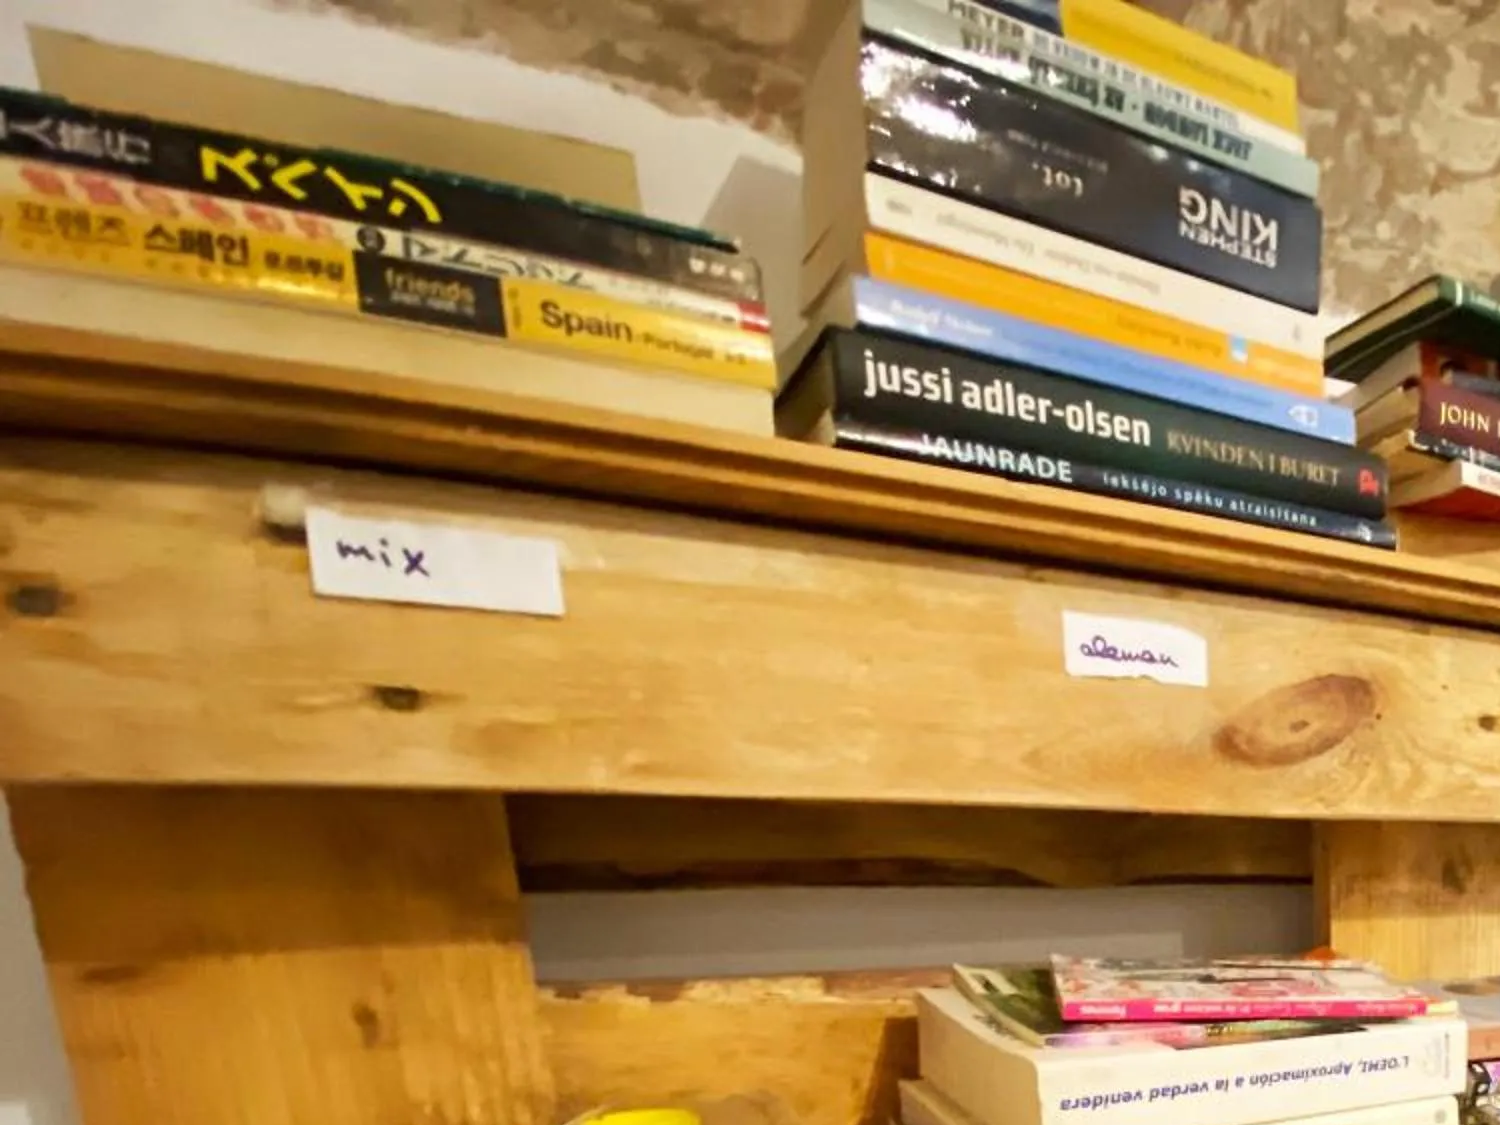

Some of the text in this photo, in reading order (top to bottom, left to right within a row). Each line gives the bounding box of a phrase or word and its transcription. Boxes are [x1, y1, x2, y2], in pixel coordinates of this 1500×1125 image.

[199, 143, 443, 225] スペイン
[1178, 184, 1280, 254] KING
[144, 223, 251, 268] 스페인
[1178, 222, 1279, 269] STEPHEN
[539, 300, 635, 344] Spain
[862, 349, 1152, 448] jussi adler-olsen
[1439, 400, 1491, 434] JOHN
[920, 432, 1073, 484] JAUNRADE
[1166, 428, 1266, 471] KVINDEN
[335, 537, 431, 579] mix
[1079, 634, 1180, 668] aleman
[1147, 1081, 1212, 1102] verdad
[1214, 1078, 1231, 1092] la
[1249, 1059, 1353, 1088] Aproximación
[1058, 1088, 1145, 1112] venidera
